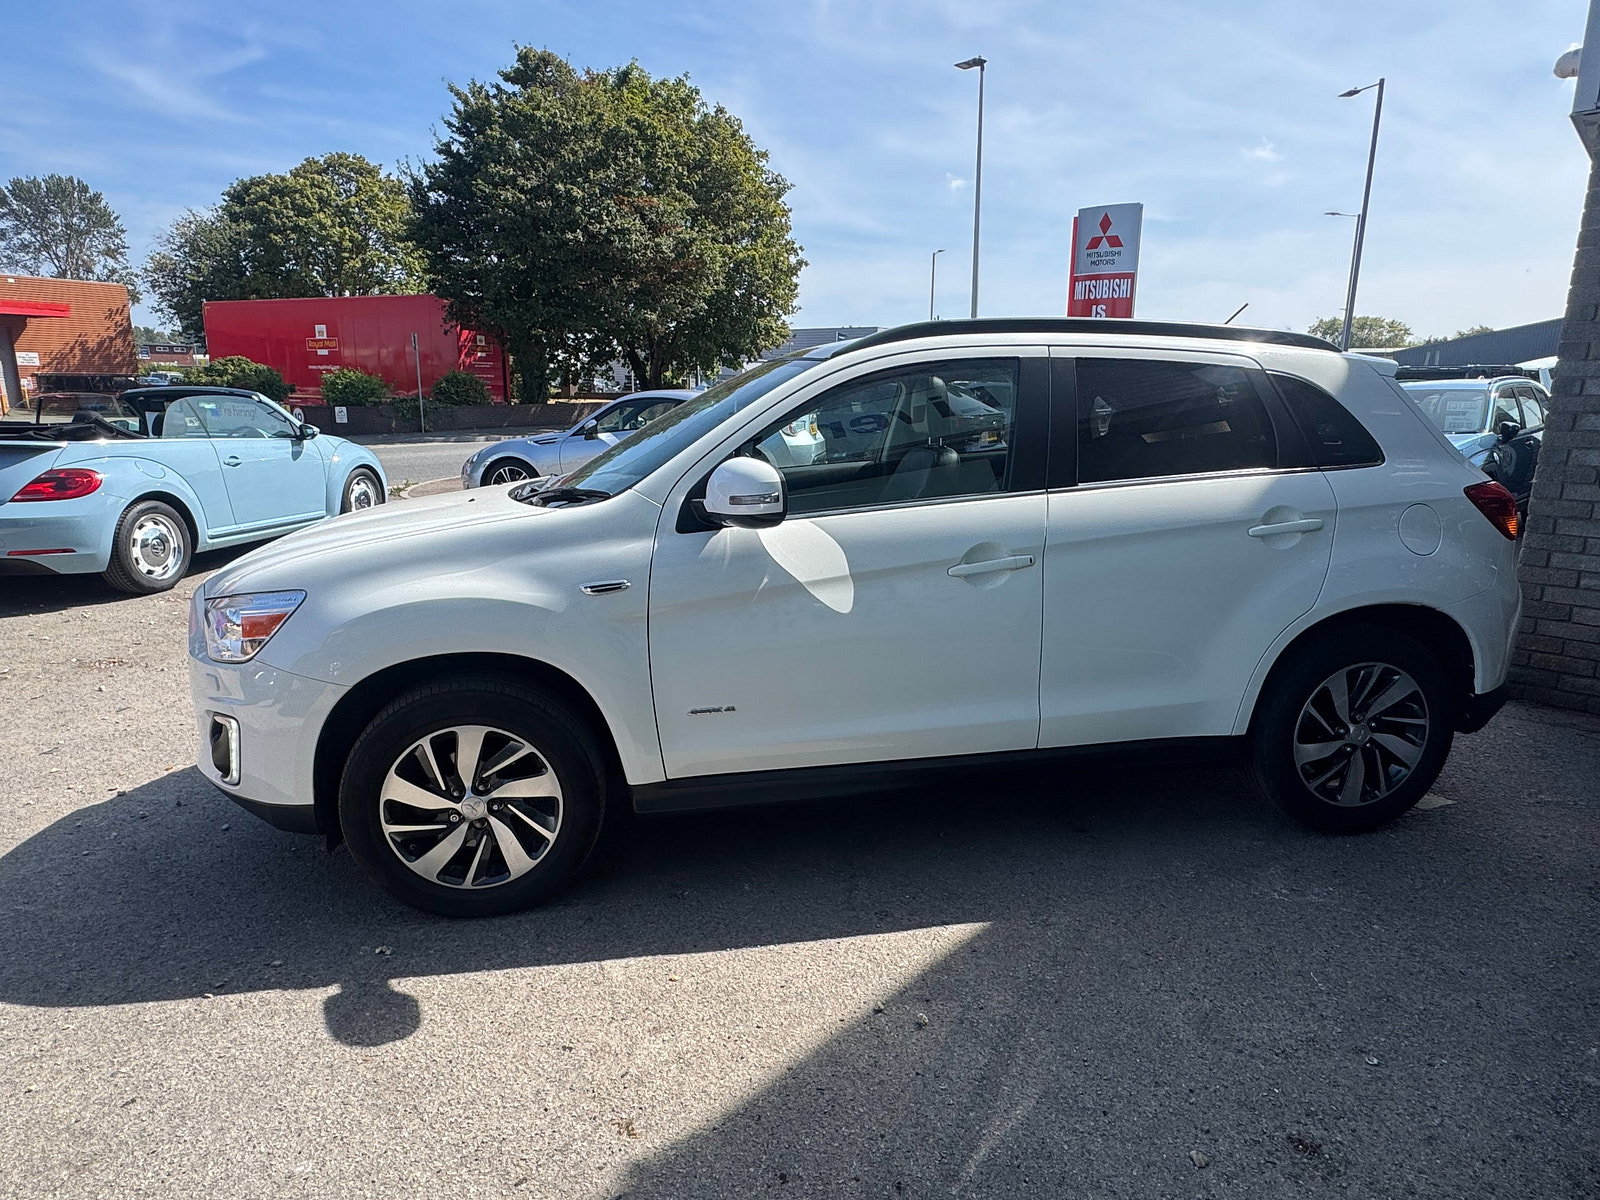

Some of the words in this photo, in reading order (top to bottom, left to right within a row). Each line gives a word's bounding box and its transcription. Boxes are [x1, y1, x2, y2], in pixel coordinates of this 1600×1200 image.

[1086, 250, 1122, 258] MITSUBISHI
[1090, 258, 1116, 267] MOTORS
[1074, 279, 1131, 300] MITSUBISHI
[1091, 304, 1107, 318] IS
[308, 340, 324, 348] Royal
